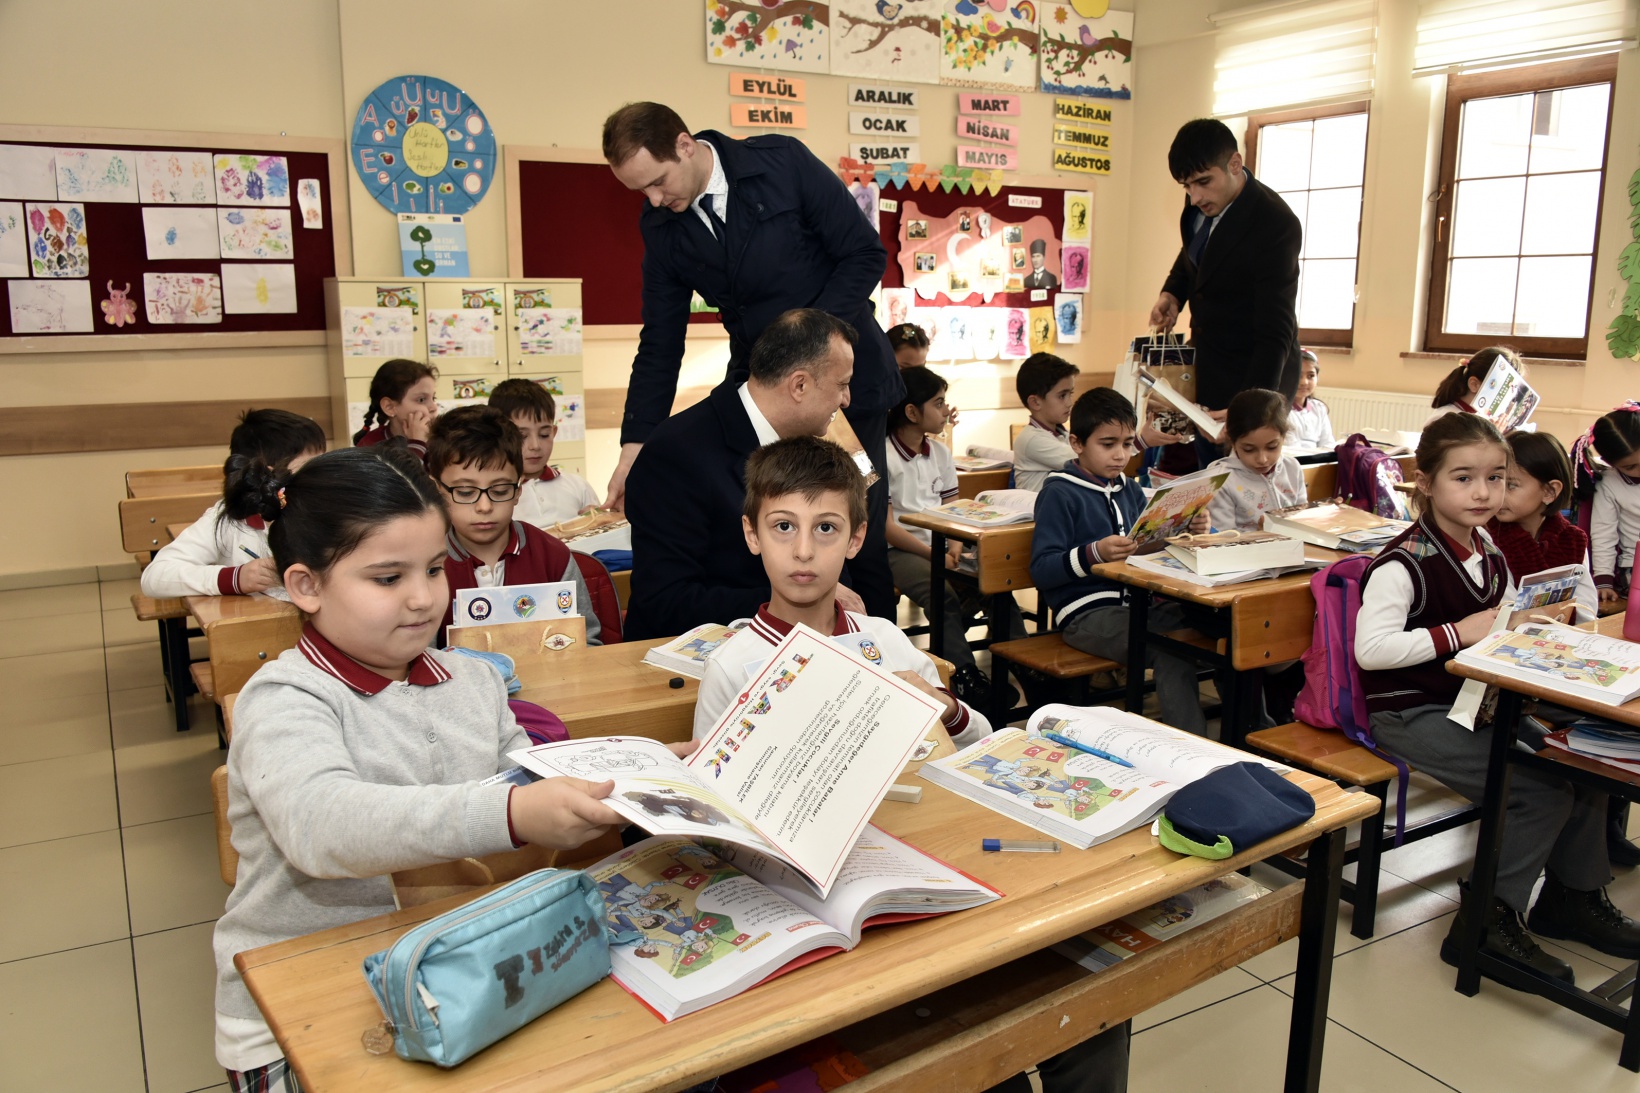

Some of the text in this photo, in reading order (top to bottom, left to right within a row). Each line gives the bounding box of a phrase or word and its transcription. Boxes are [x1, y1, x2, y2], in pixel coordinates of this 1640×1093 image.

[743, 78, 797, 97] EYLÜL
[854, 89, 914, 105] ARALIK
[748, 106, 793, 124] EKİM
[971, 99, 1009, 111] MART
[1056, 103, 1111, 121] HAZİRAN
[862, 117, 907, 132] OCAK
[966, 120, 1009, 141] NİSAN
[1055, 129, 1109, 147] TEMMUZ
[860, 147, 910, 164] ŞUBAT
[965, 151, 1007, 165] MAYIS
[1055, 152, 1110, 171] AĞUSTOS
[835, 670, 860, 702] eğlenerek
[770, 700, 830, 779] gözlerinizden öpüyorum.
[802, 713, 828, 746] öğrenerek
[820, 719, 840, 744] Sevgili
[764, 680, 861, 817] Sizler için hazırladığımız boyama kitabını
[848, 722, 879, 764] Saygıdeğer
[758, 746, 777, 771] Kamuran
[773, 748, 802, 789] kullanmanız
[776, 686, 879, 836] örnek olduğunuzdan dolayı teşekkür ederim.
[788, 698, 880, 830] trafikte doğru davranışları sergileyerek
[790, 695, 890, 842] Geleceğimizin teminatı olan çocuklarımıza
[796, 745, 820, 778] Çocuklar
[737, 746, 772, 797] Gümüşhane Valisi
[832, 764, 847, 784] Anne
[755, 791, 773, 820] dileğiyle
[812, 787, 833, 816] Babalar
